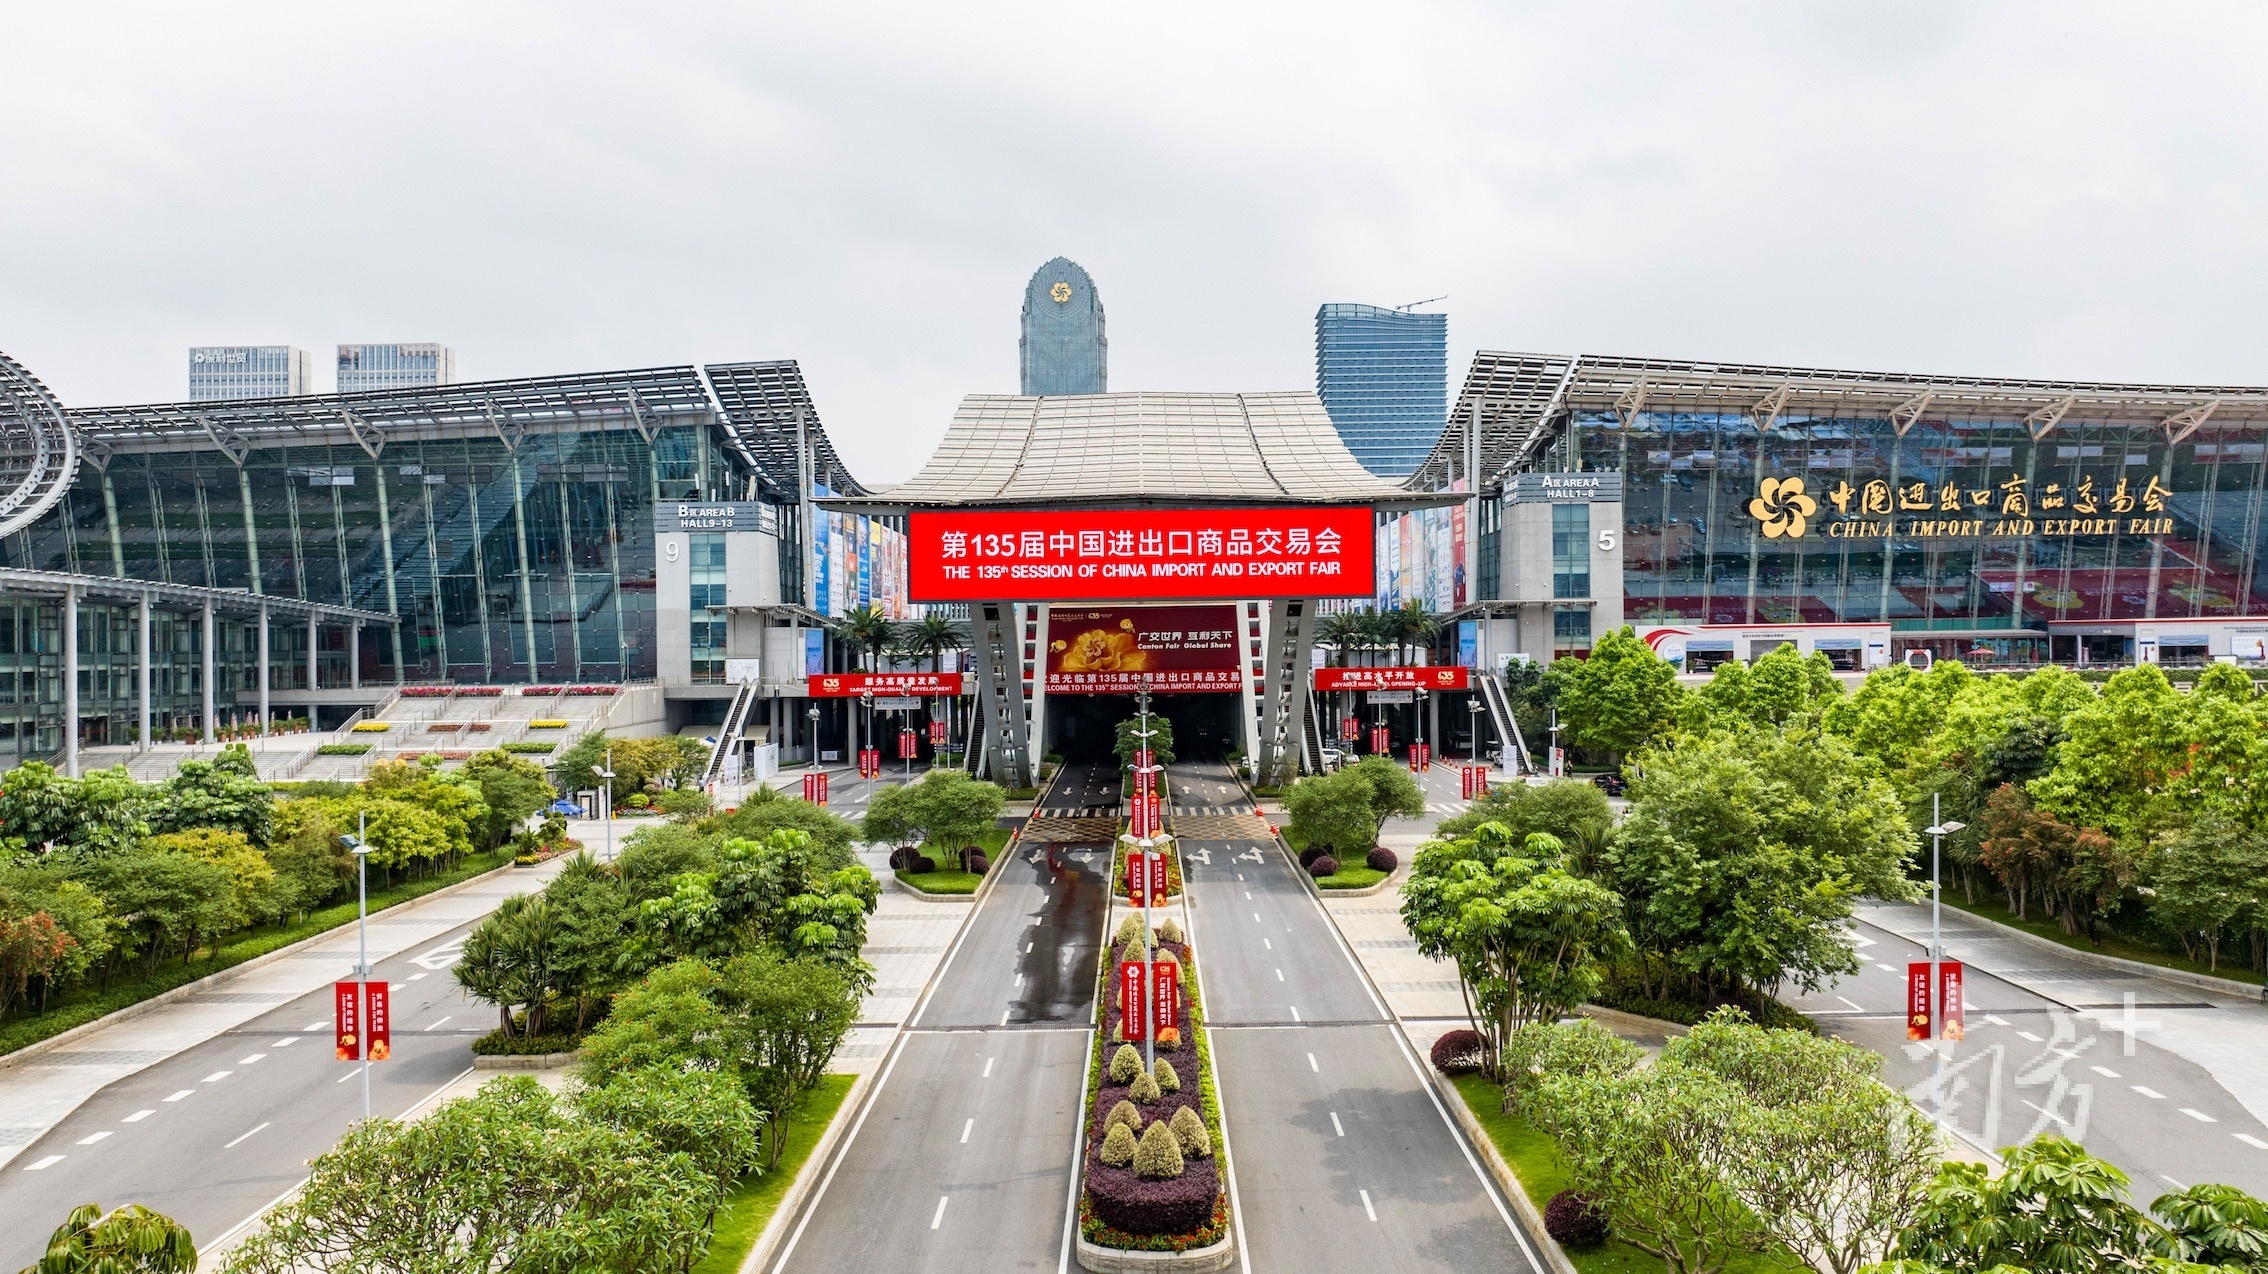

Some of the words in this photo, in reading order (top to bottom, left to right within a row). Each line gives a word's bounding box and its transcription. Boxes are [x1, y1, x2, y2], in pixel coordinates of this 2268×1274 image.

[205, 352, 247, 364] 保利世贸
[1829, 521, 1893, 538] CHINA
[1910, 520, 1984, 536] IMPORT
[1992, 519, 2035, 536] AND
[2043, 518, 2117, 536] EXPORT
[2129, 518, 2174, 534] FAIR
[941, 527, 1342, 560] 第135届中国进出口商品交易会
[1598, 530, 1616, 551] 5
[666, 541, 679, 562] 9
[943, 566, 970, 579] THE
[1011, 564, 1072, 579] SESSION
[1078, 564, 1098, 578] OF
[1102, 563, 1147, 578] CHINA
[1152, 562, 1206, 578] IMPORT
[1211, 562, 1244, 577] AND
[1249, 562, 1304, 576] EXPORT
[1310, 561, 1342, 576] FAIR
[1138, 632, 1182, 642] 广交世界
[1187, 630, 1233, 641] 互利天下
